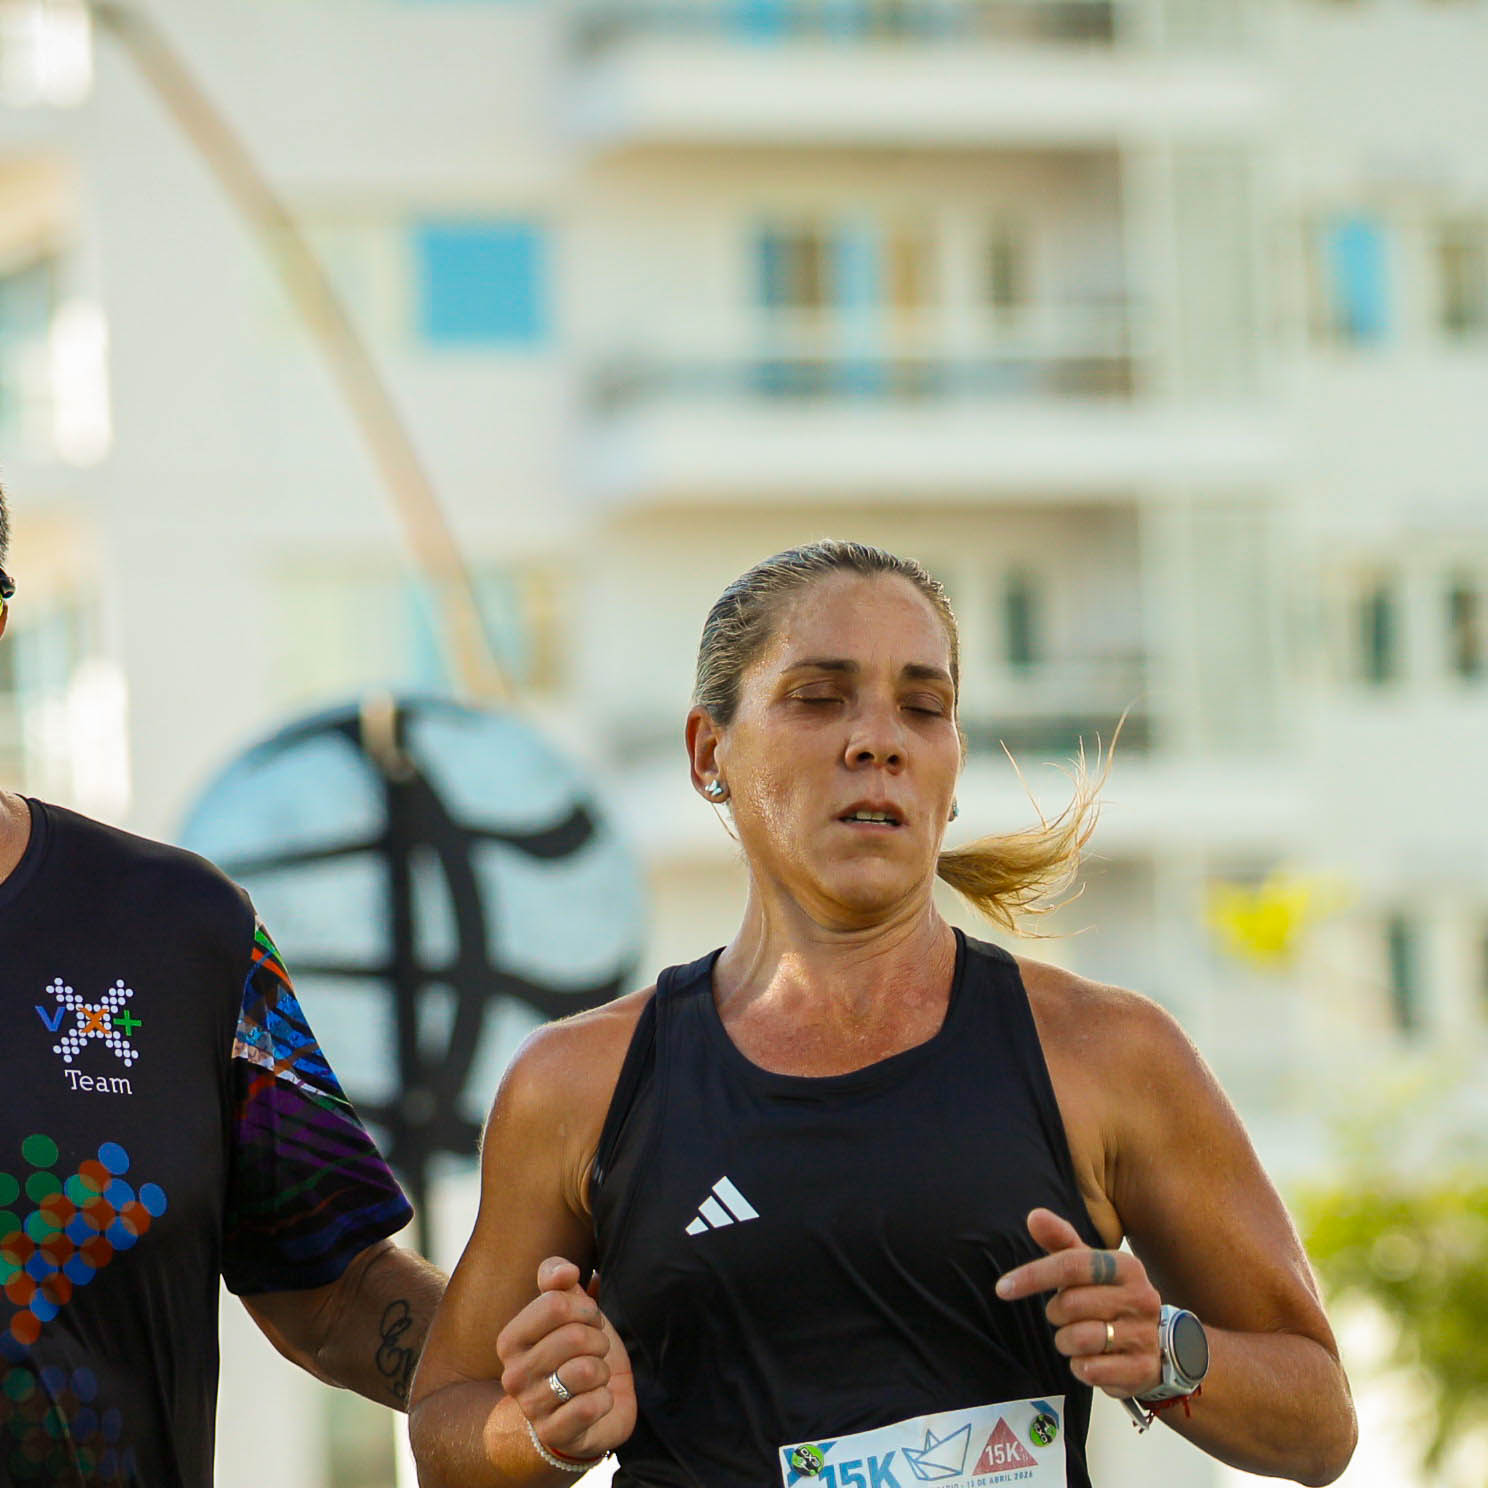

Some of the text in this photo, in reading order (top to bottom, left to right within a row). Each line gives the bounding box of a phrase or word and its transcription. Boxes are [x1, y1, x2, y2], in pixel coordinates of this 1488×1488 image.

[64, 1068, 133, 1095] Team
[985, 1441, 1021, 1466] 15K
[989, 1475, 1011, 1485] ABRIL
